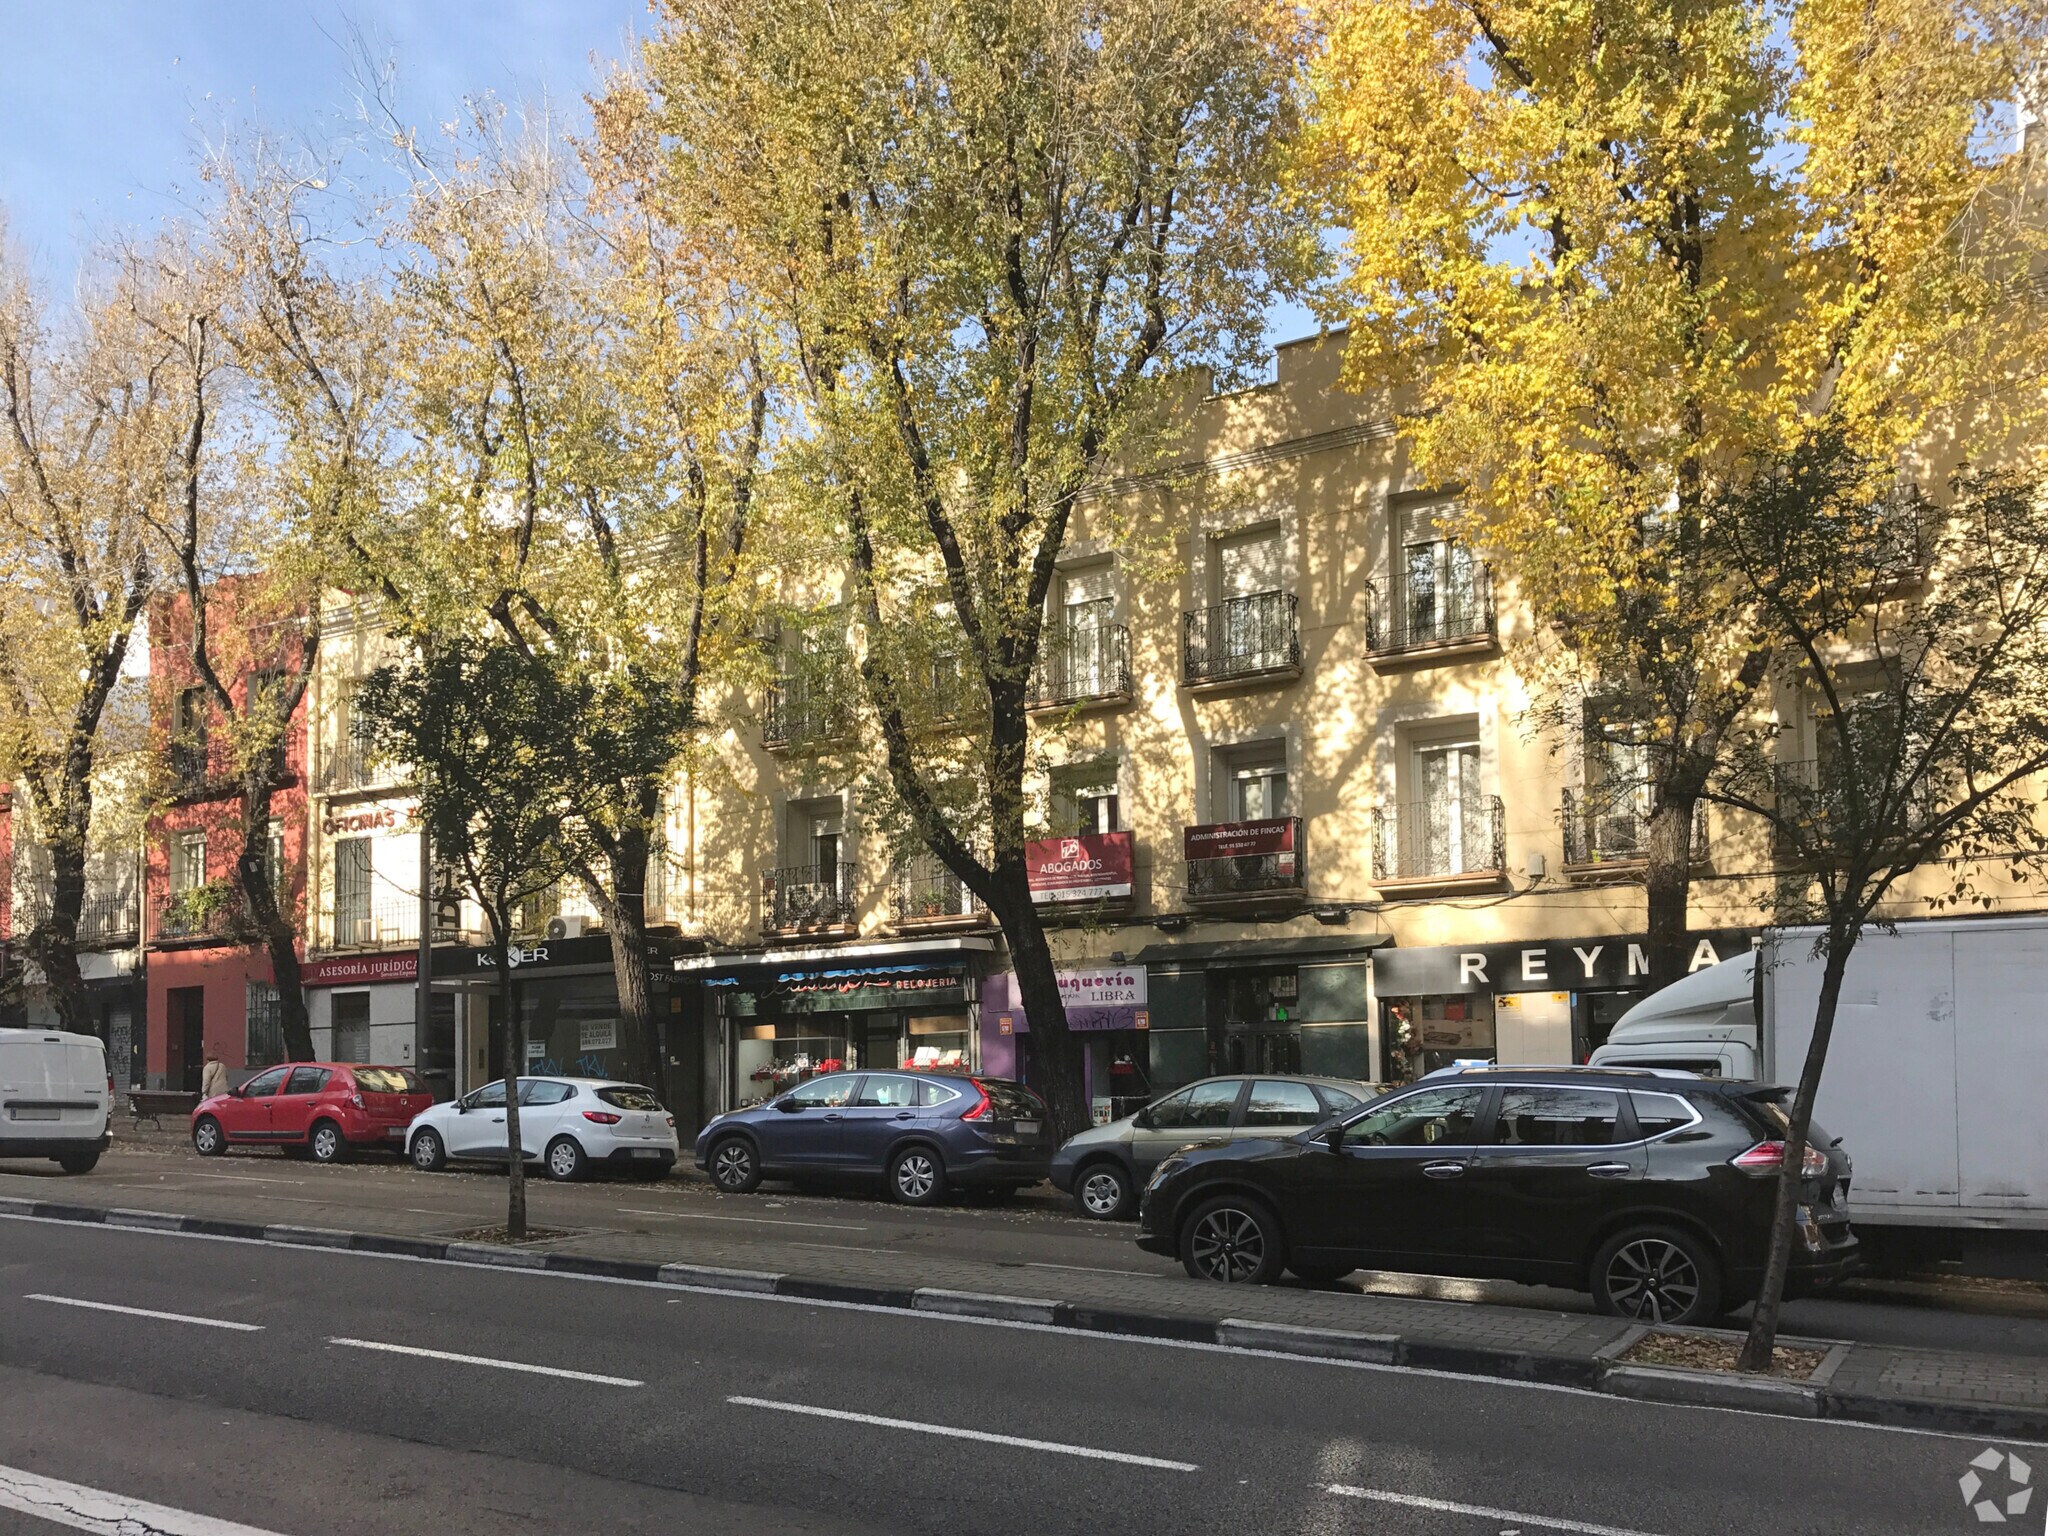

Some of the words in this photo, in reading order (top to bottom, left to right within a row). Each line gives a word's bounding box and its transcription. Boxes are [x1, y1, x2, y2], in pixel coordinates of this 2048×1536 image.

[1190, 829, 1249, 841] ADMINISTRACIÓN
[1249, 828, 1259, 836] DE
[1260, 825, 1285, 835] FINCAS
[1039, 858, 1103, 874] ABOGADOS
[1072, 889, 1087, 898] 324
[1088, 887, 1104, 896] 777
[319, 962, 369, 977] ASESORÍA
[896, 976, 958, 990] RELOJERIA
[1091, 990, 1136, 1002] LIBRA
